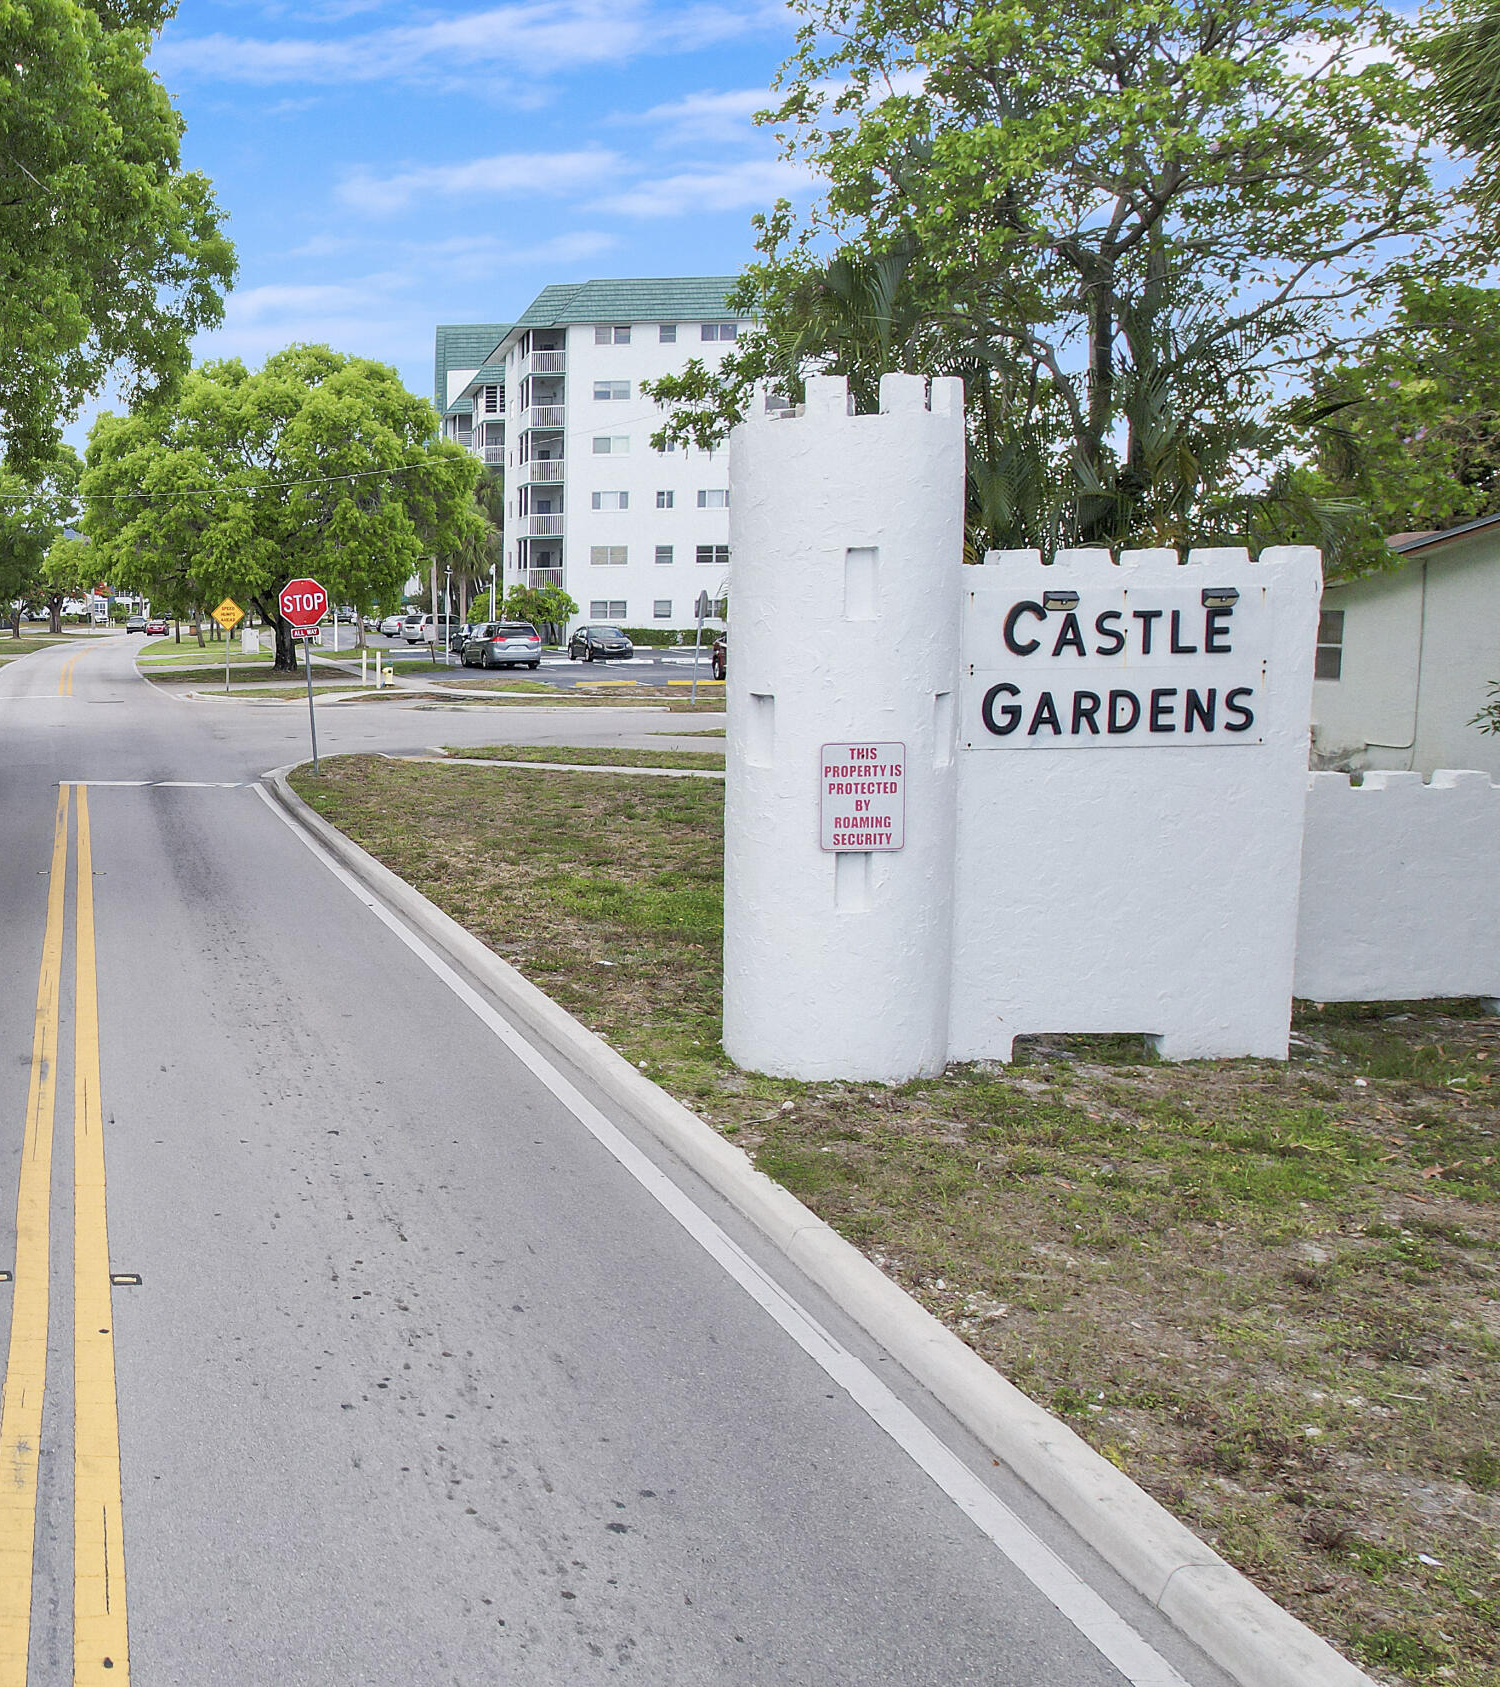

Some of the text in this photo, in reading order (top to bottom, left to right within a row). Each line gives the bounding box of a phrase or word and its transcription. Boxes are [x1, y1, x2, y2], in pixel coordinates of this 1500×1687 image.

[283, 592, 324, 612] STOP
[1003, 599, 1234, 657] CASTLE
[981, 682, 1254, 736] GARDENS
[849, 747, 877, 760] THIS
[824, 764, 902, 777] PROPERTY IS
[828, 782, 897, 794] PROTECTED
[855, 799, 871, 811] BY
[834, 816, 891, 828] ROAMING
[833, 833, 892, 846] SECURITY
